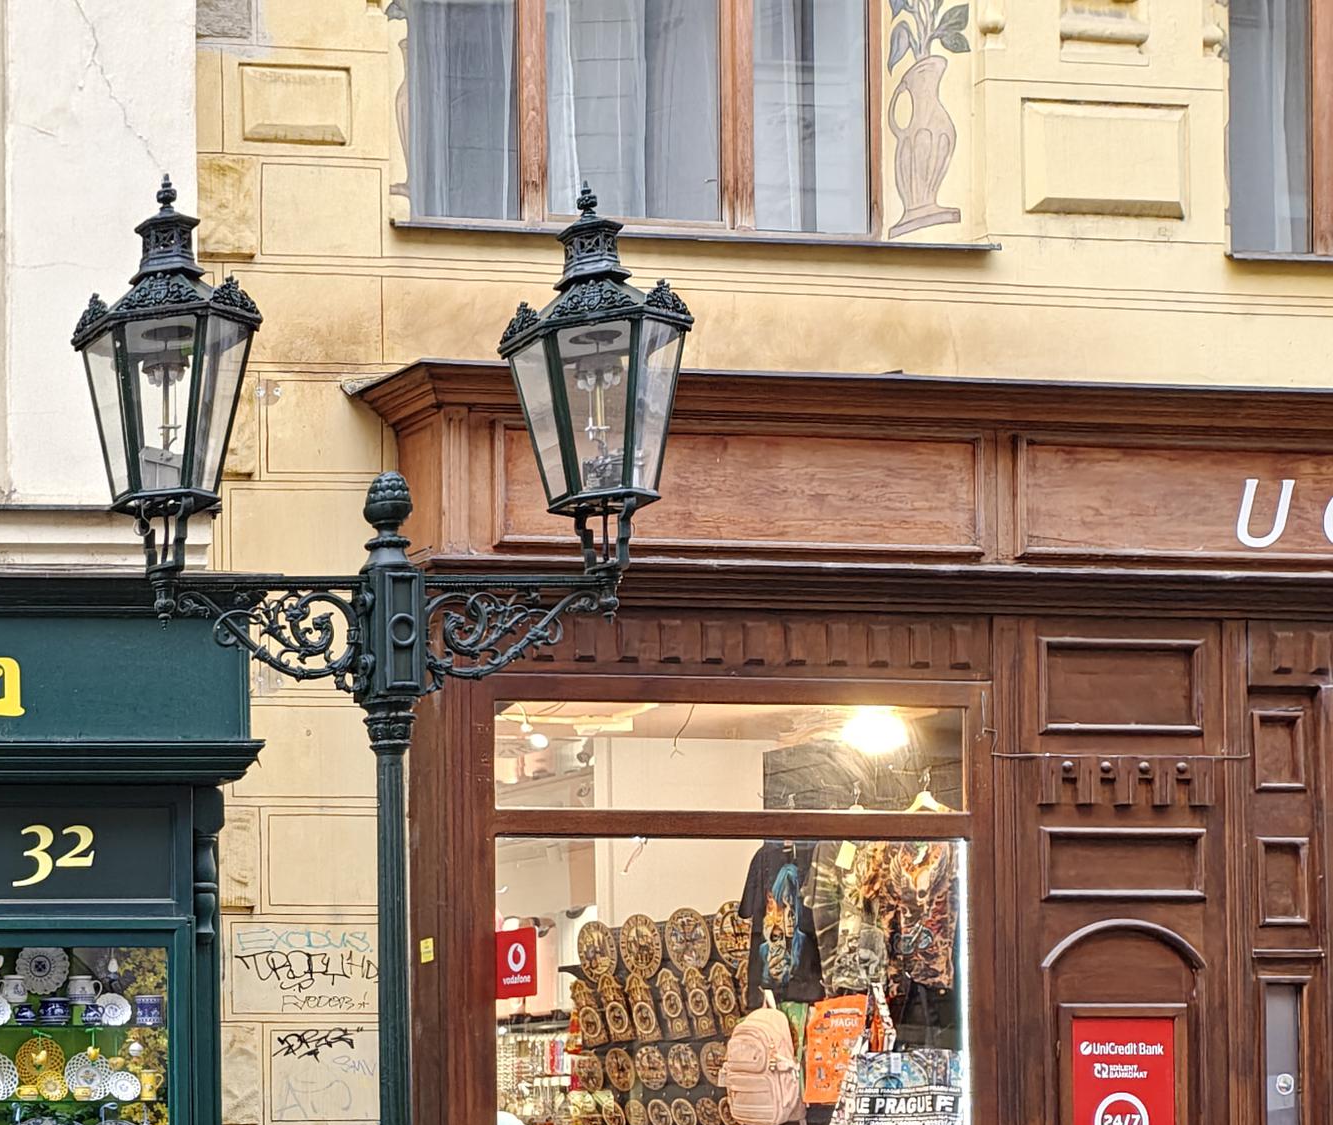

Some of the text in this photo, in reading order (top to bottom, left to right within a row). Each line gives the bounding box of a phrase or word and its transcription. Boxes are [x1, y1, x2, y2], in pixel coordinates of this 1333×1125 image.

[12, 824, 96, 888] 32
[1092, 1042, 1164, 1055] UniCredit Bank
[874, 1095, 933, 1114] PRAGUE
